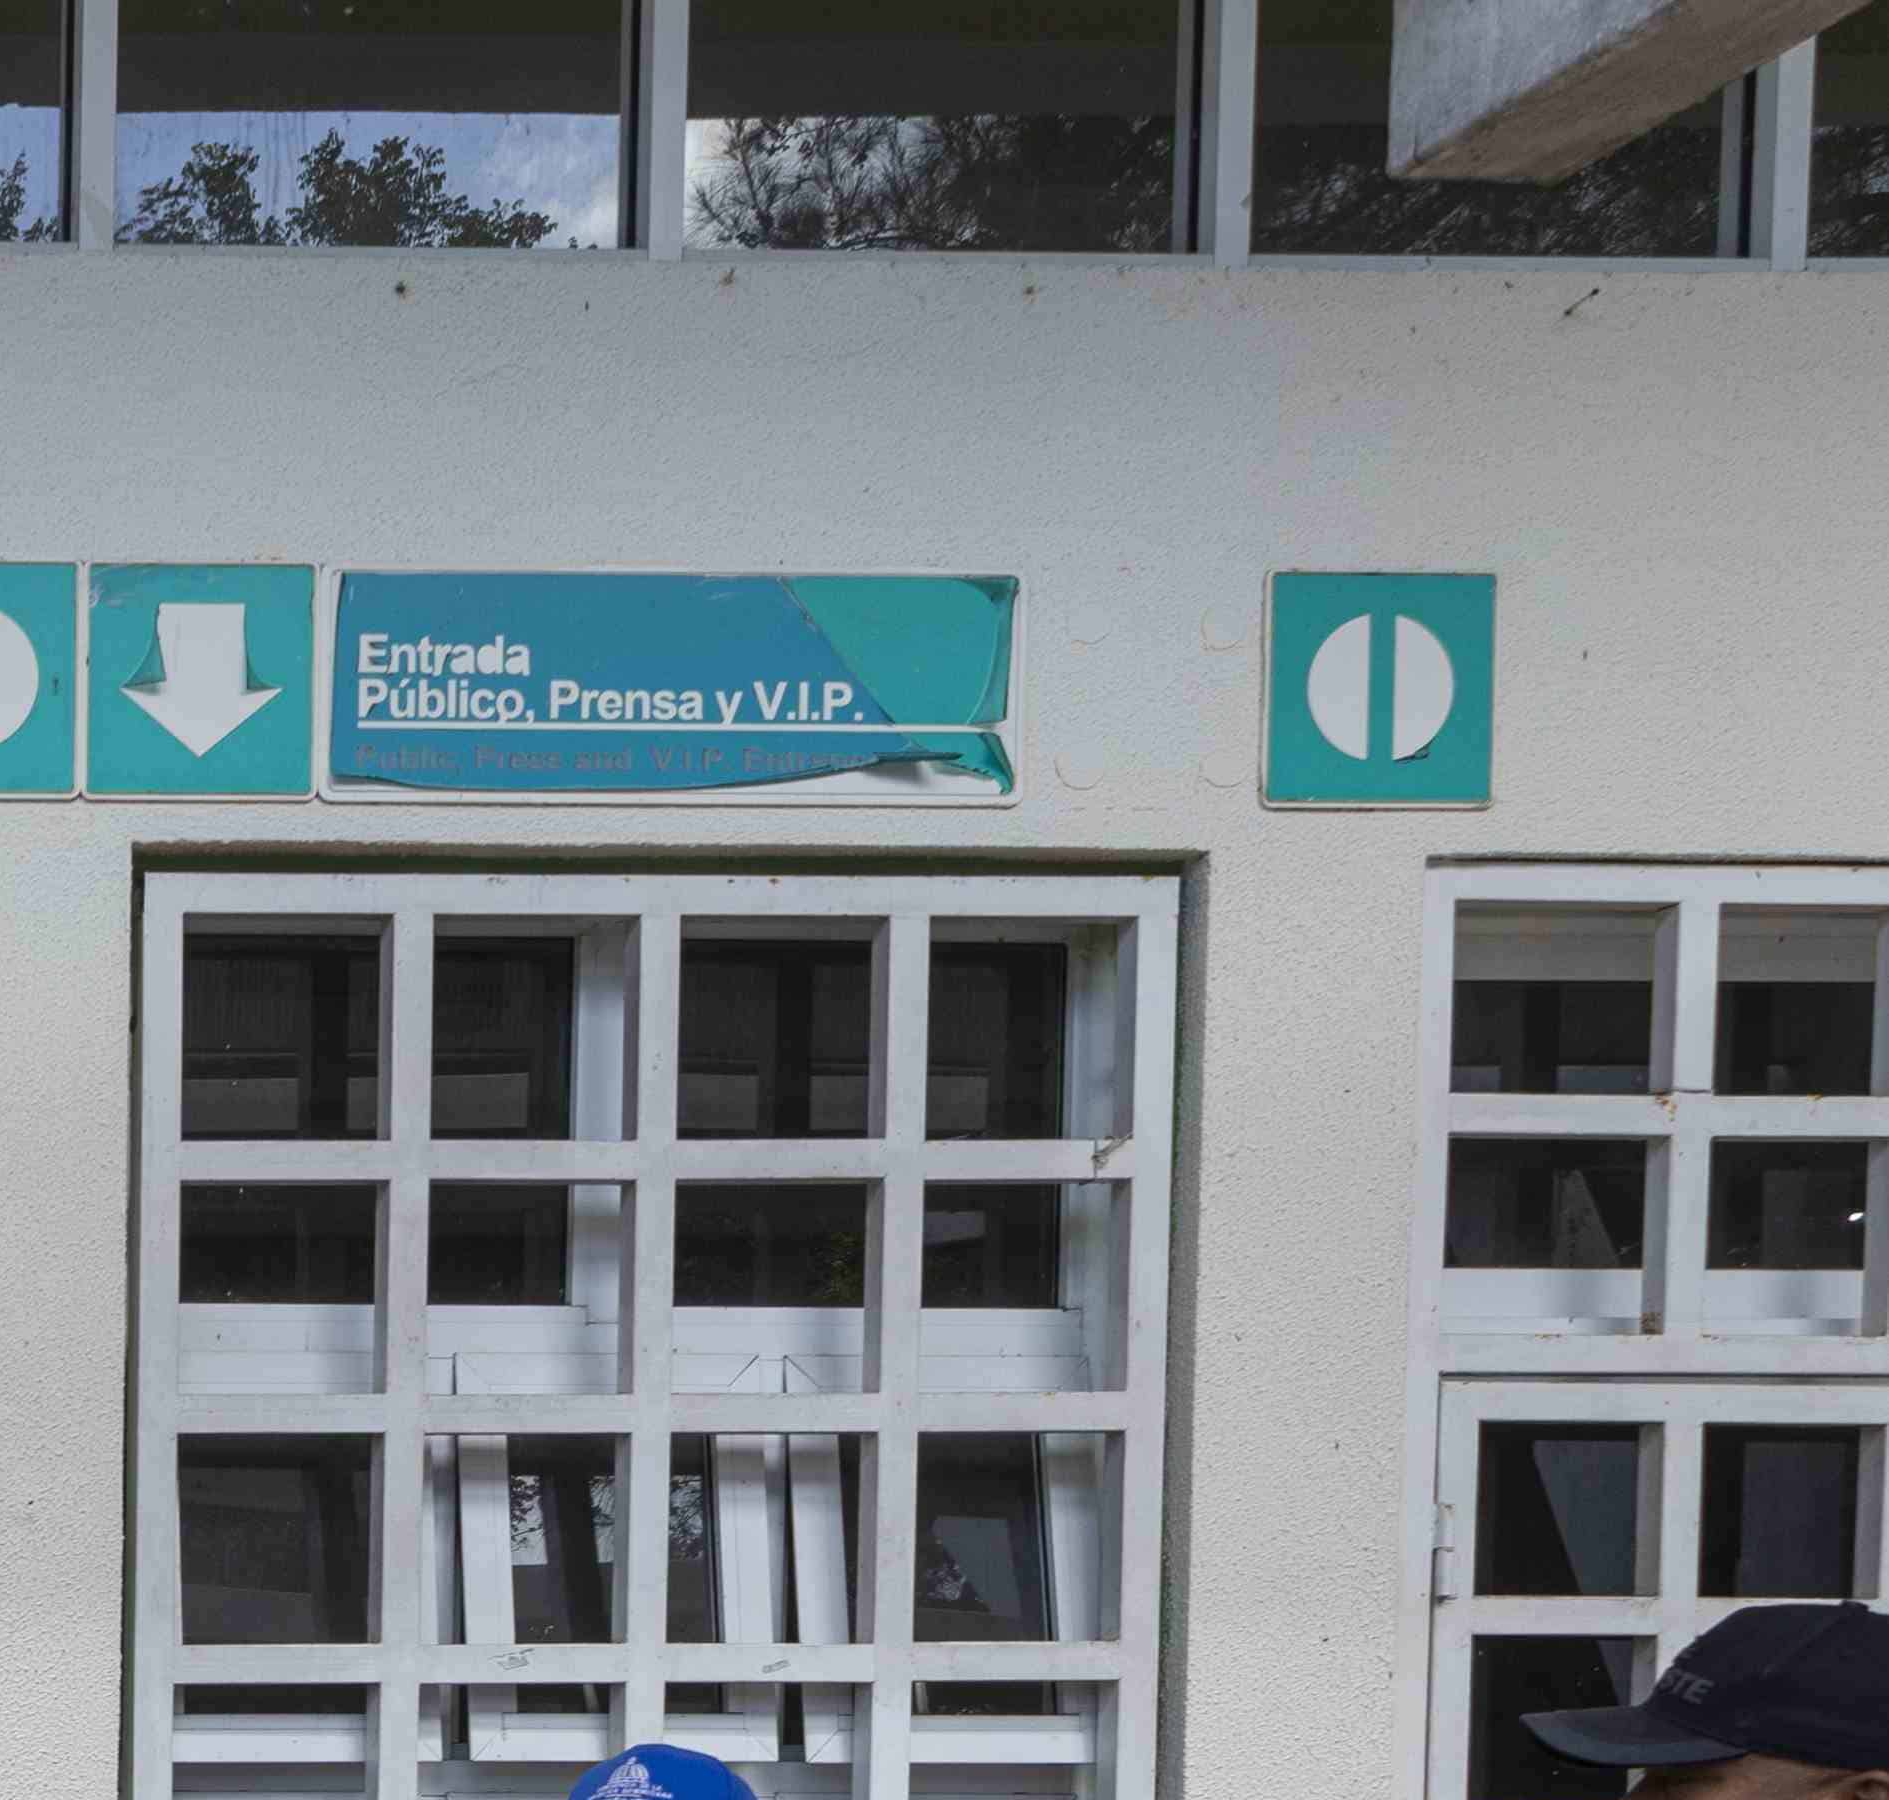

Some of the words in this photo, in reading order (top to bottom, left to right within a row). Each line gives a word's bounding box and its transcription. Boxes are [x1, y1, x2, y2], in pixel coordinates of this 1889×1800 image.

[357, 633, 530, 676] Entrada
[357, 679, 535, 724] Público,
[549, 680, 703, 720] Prensa
[716, 690, 743, 724] y
[752, 681, 864, 720] V.I.P.
